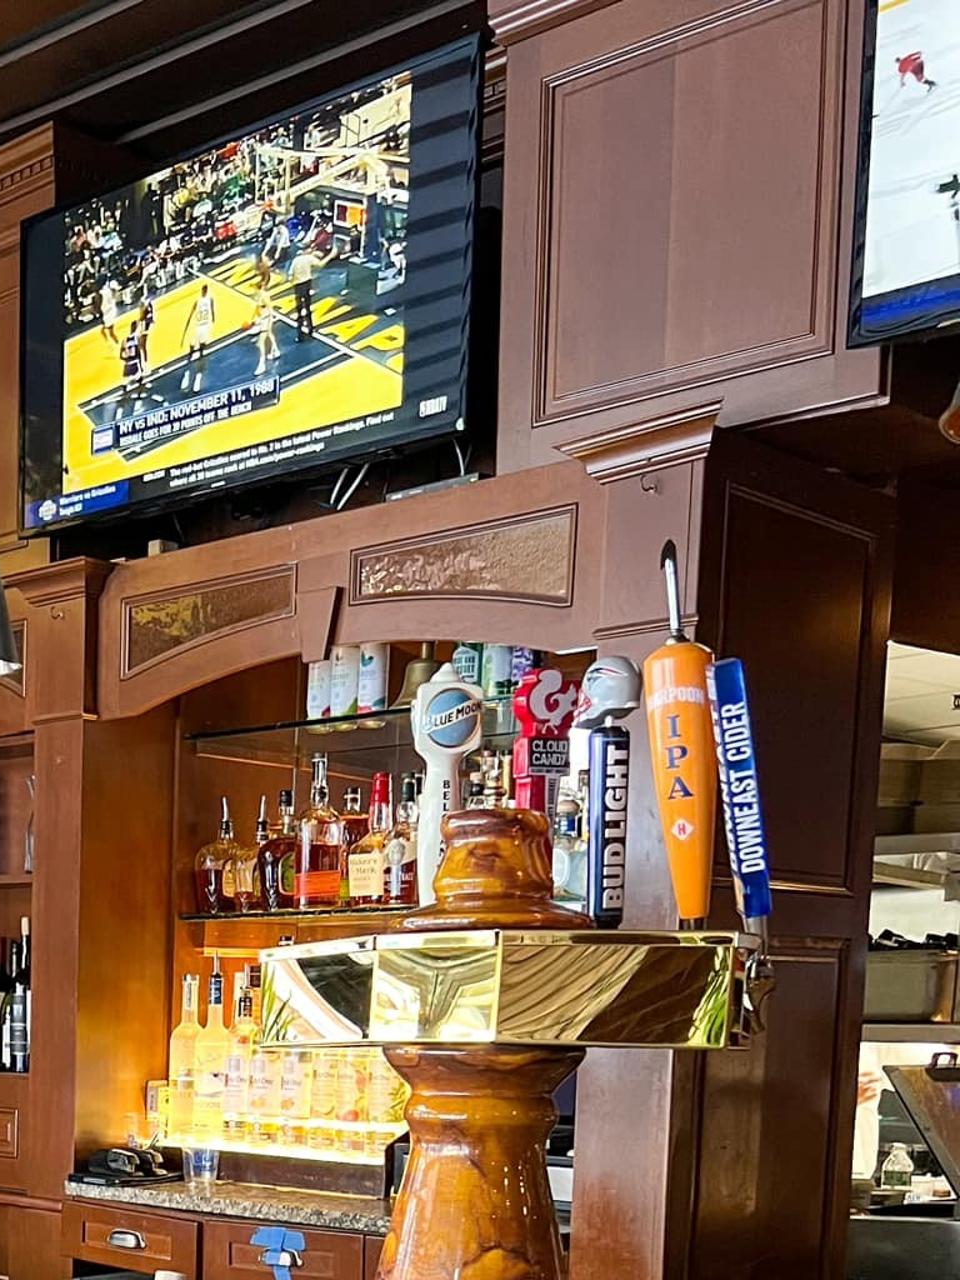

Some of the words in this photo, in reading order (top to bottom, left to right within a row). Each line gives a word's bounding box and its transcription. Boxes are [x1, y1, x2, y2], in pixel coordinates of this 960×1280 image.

[170, 394, 229, 422] NOVEMBER
[455, 701, 482, 720] MOON
[721, 701, 752, 762] CIDER
[532, 740, 568, 752] CLOUD
[532, 753, 566, 765] CANDY
[604, 745, 628, 839] LIGHT
[729, 769, 766, 875] DOWNEAST
[602, 842, 625, 910] BUD
